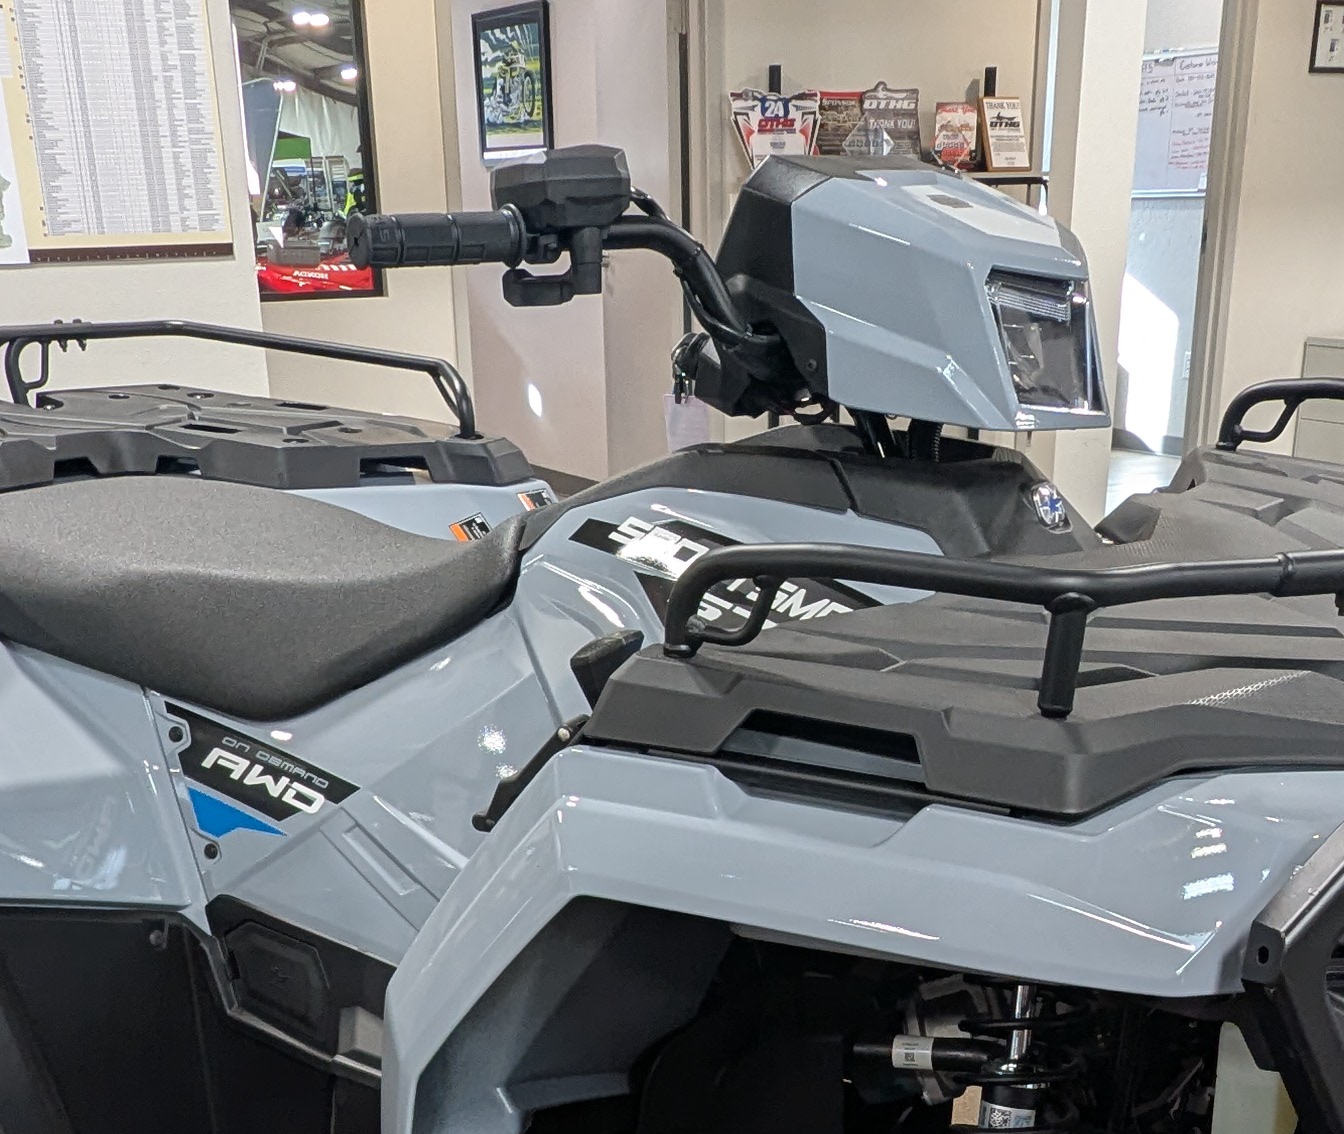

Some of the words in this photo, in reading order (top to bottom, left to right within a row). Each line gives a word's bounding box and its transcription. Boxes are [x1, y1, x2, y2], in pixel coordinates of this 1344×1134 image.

[201, 747, 325, 814] AWD
[222, 736, 250, 753] ON
[256, 750, 329, 789] DEMAND
